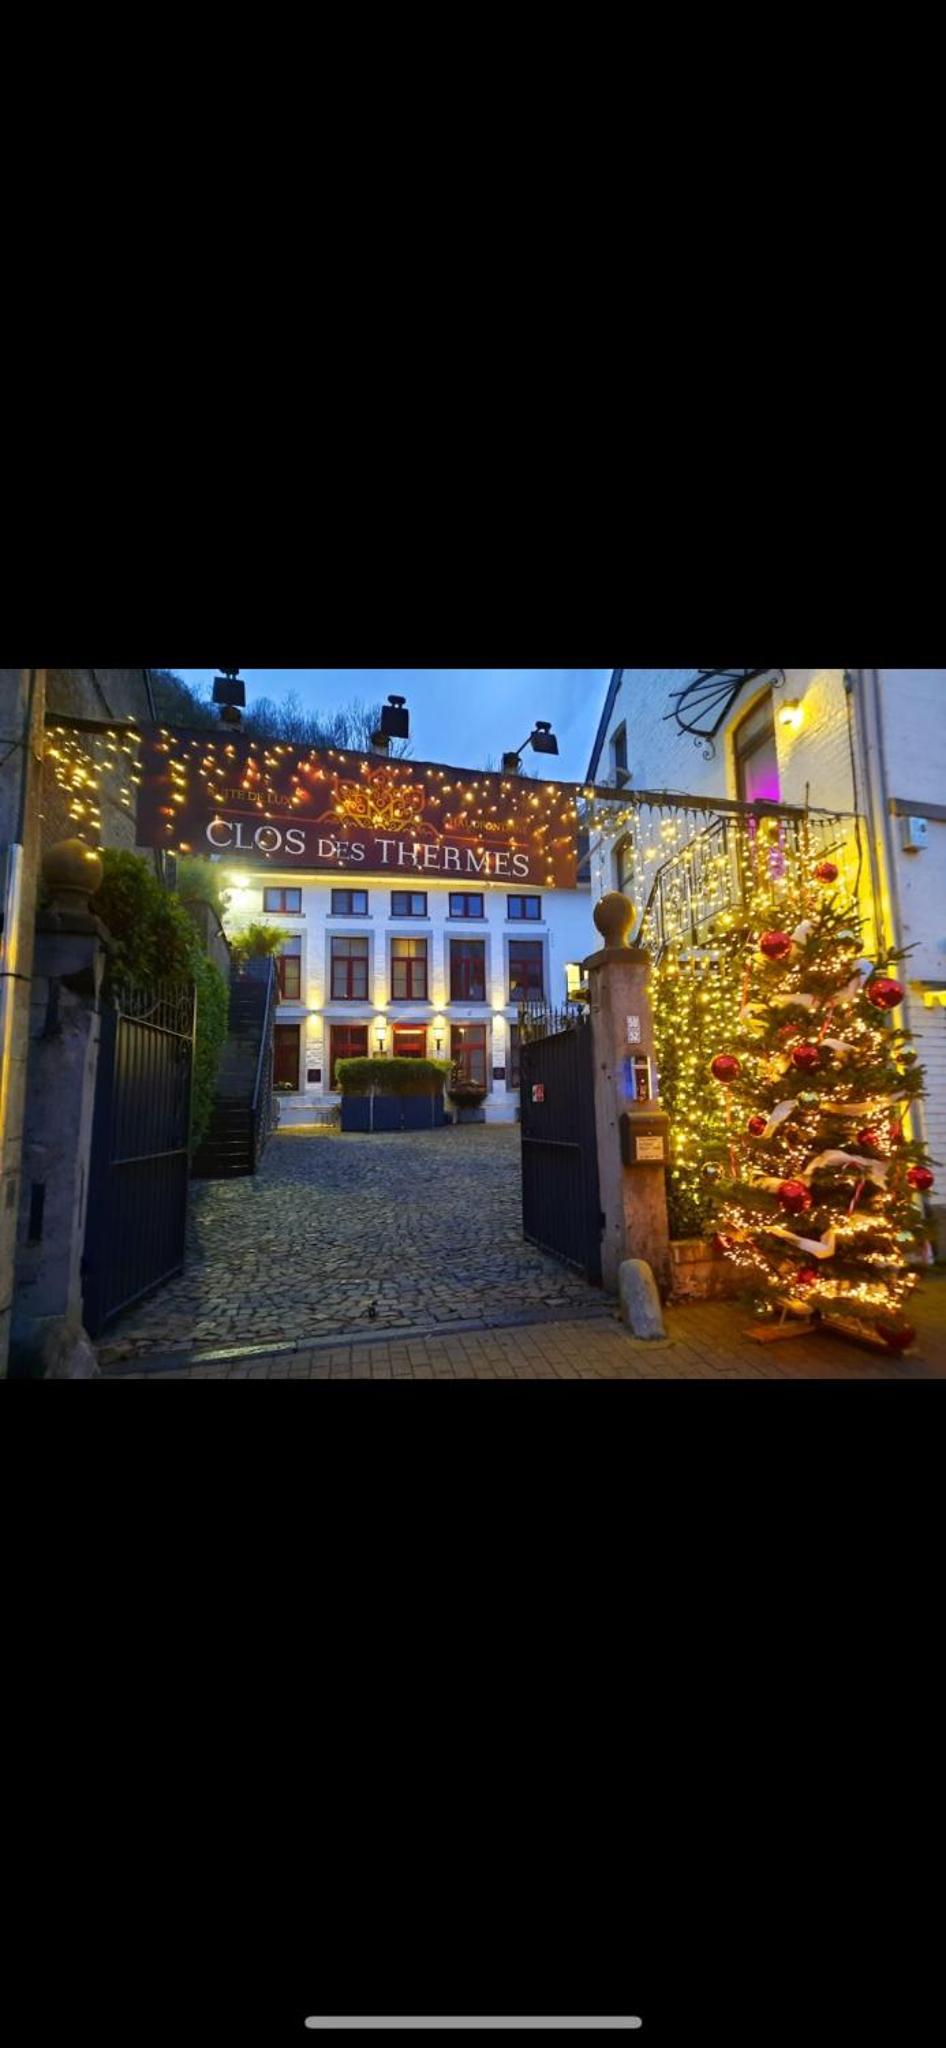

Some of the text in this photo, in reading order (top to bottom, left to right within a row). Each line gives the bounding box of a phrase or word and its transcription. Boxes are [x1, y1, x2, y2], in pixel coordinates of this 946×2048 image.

[207, 782, 245, 801] SITE
[267, 792, 300, 806] LUX
[206, 819, 529, 878] CLOS DES THERMES
